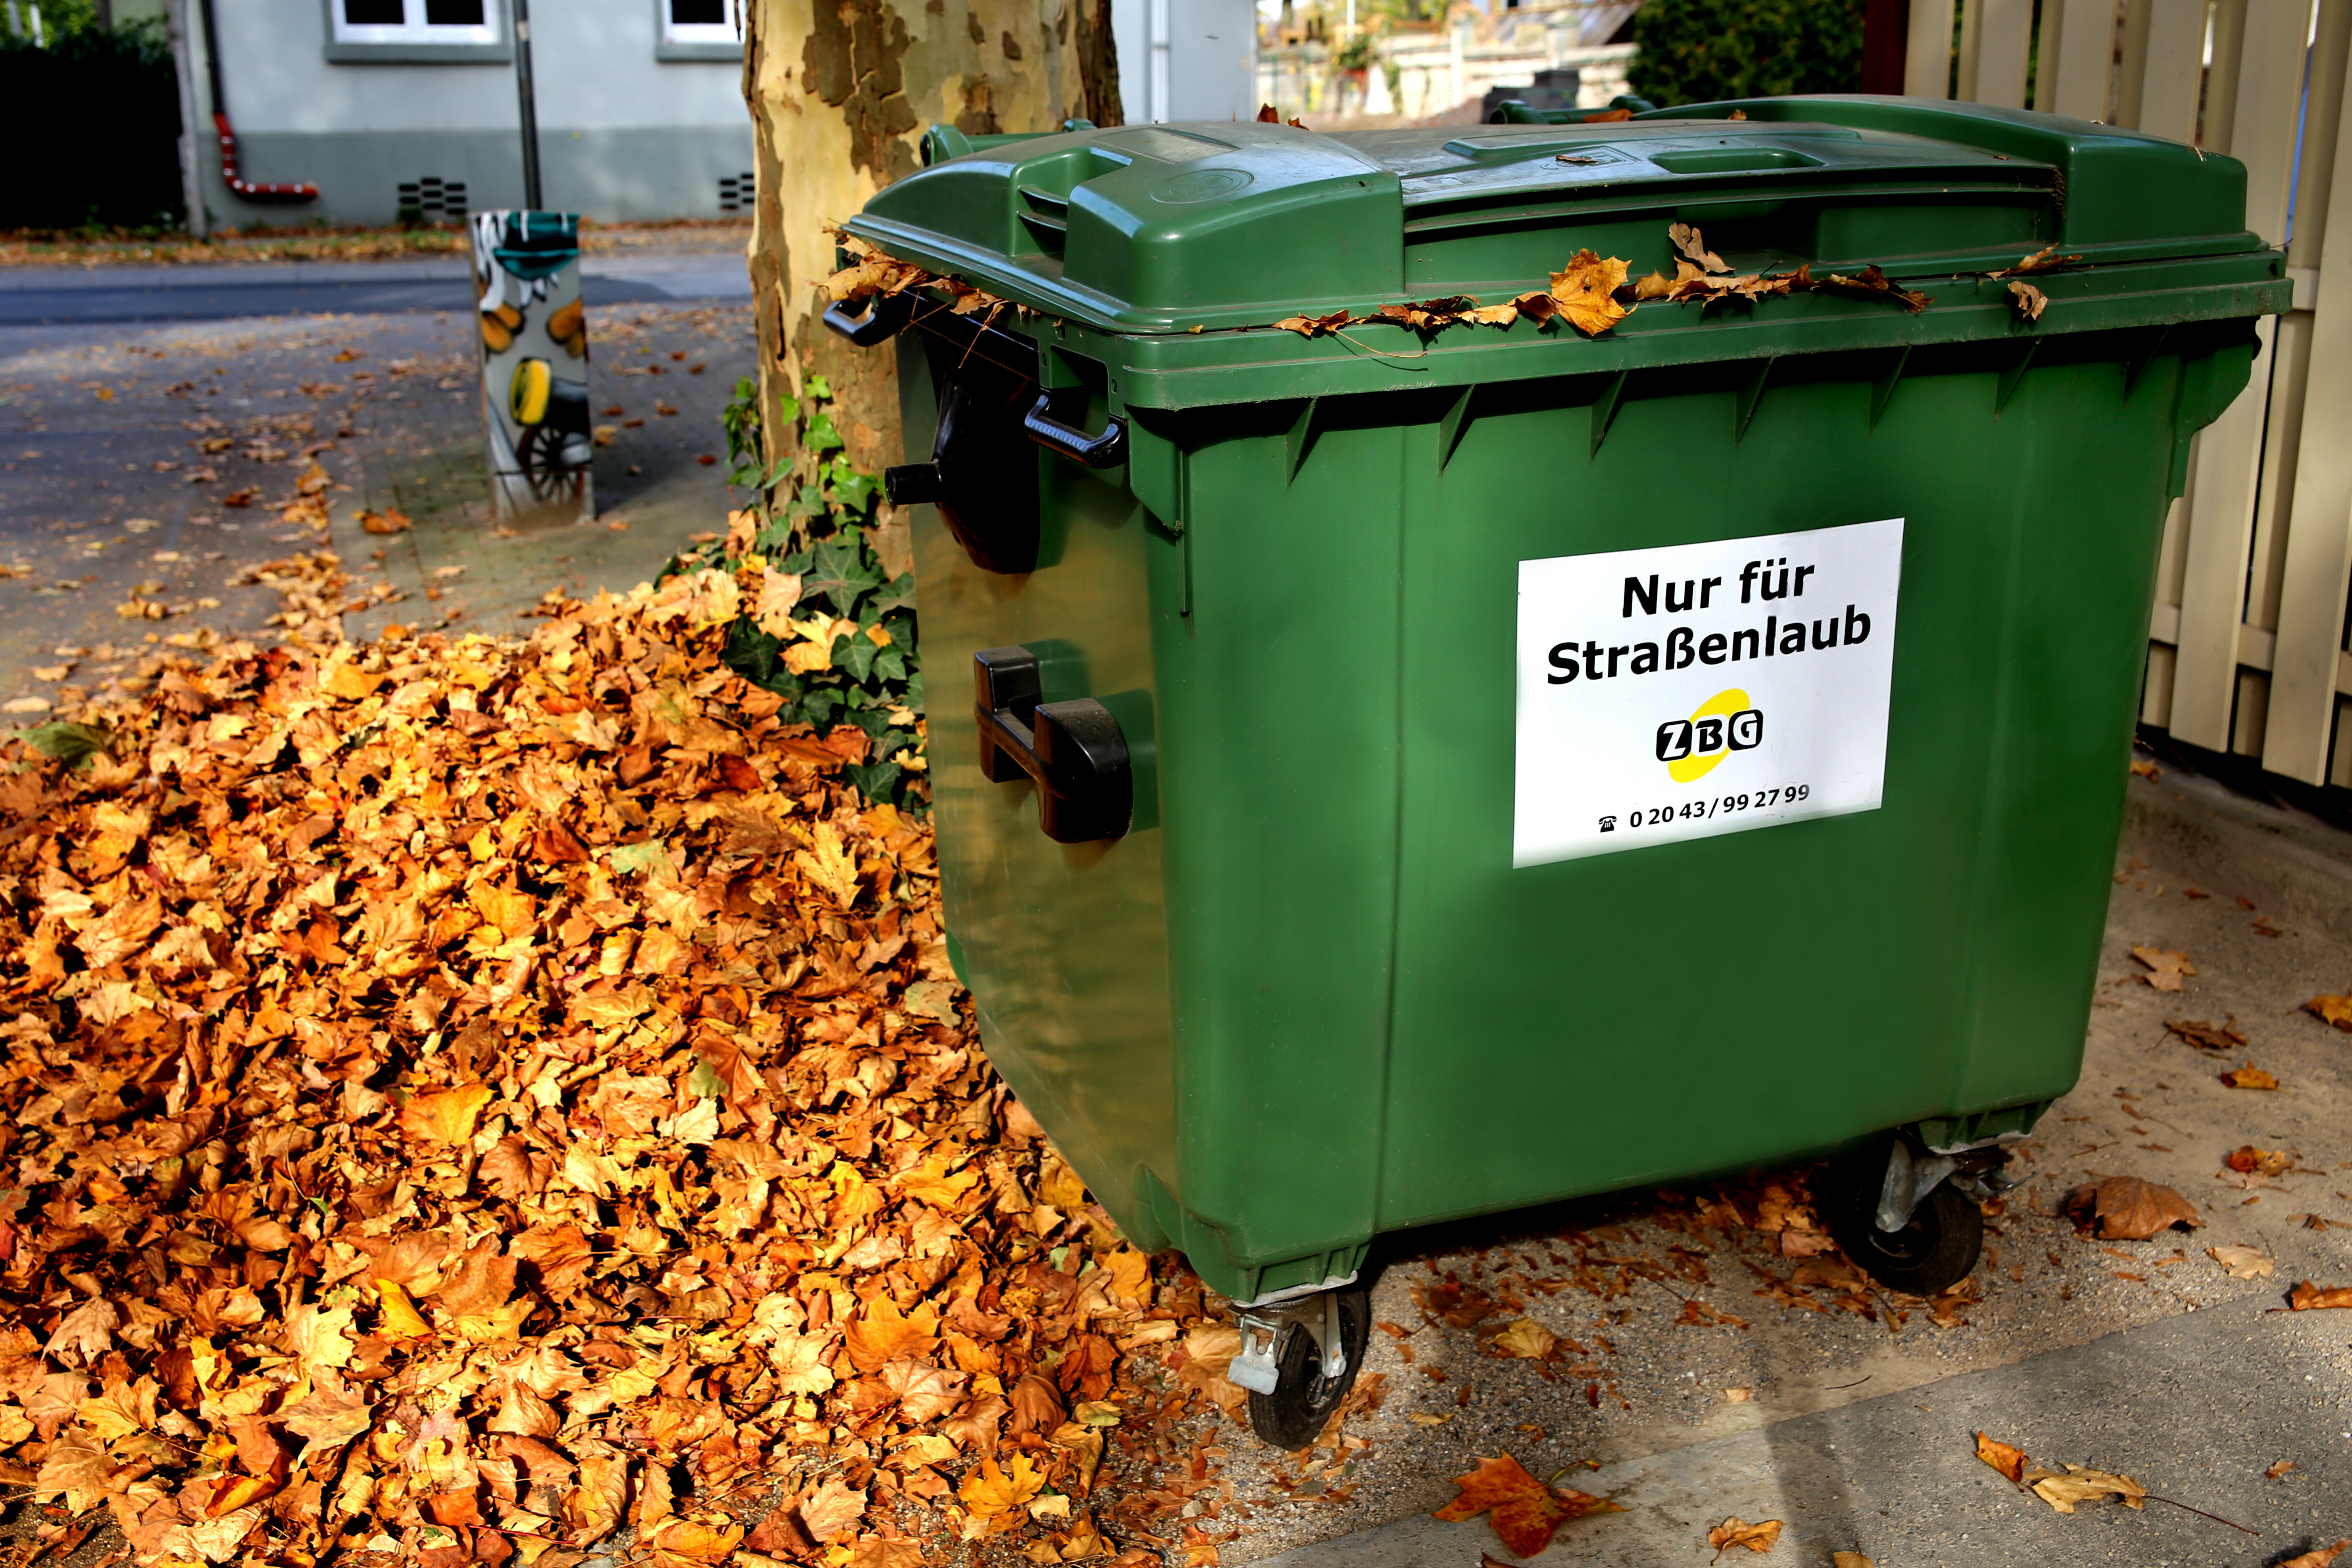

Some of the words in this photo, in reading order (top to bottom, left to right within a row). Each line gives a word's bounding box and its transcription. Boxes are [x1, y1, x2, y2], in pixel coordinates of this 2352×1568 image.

[1623, 574, 1721, 618] Nur
[1740, 558, 1814, 603] für
[1548, 604, 1871, 684] Straßenlaub
[1656, 709, 1763, 761] ZBG
